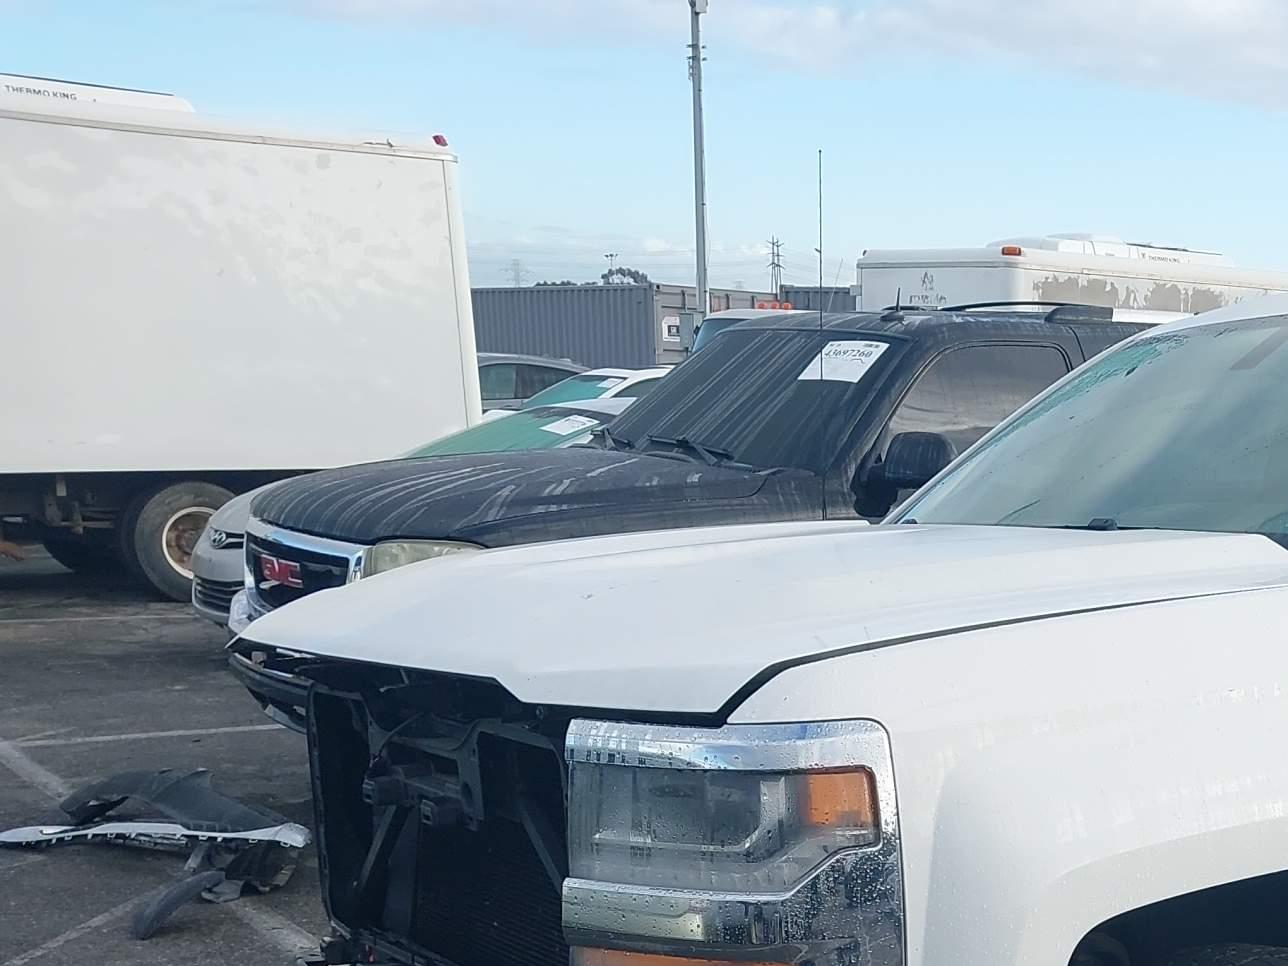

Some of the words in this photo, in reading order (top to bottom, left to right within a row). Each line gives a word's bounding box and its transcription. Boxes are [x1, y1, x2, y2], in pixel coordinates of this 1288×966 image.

[4, 84, 51, 97] THERMO
[52, 91, 77, 101] KING
[824, 349, 873, 358] 43697260
